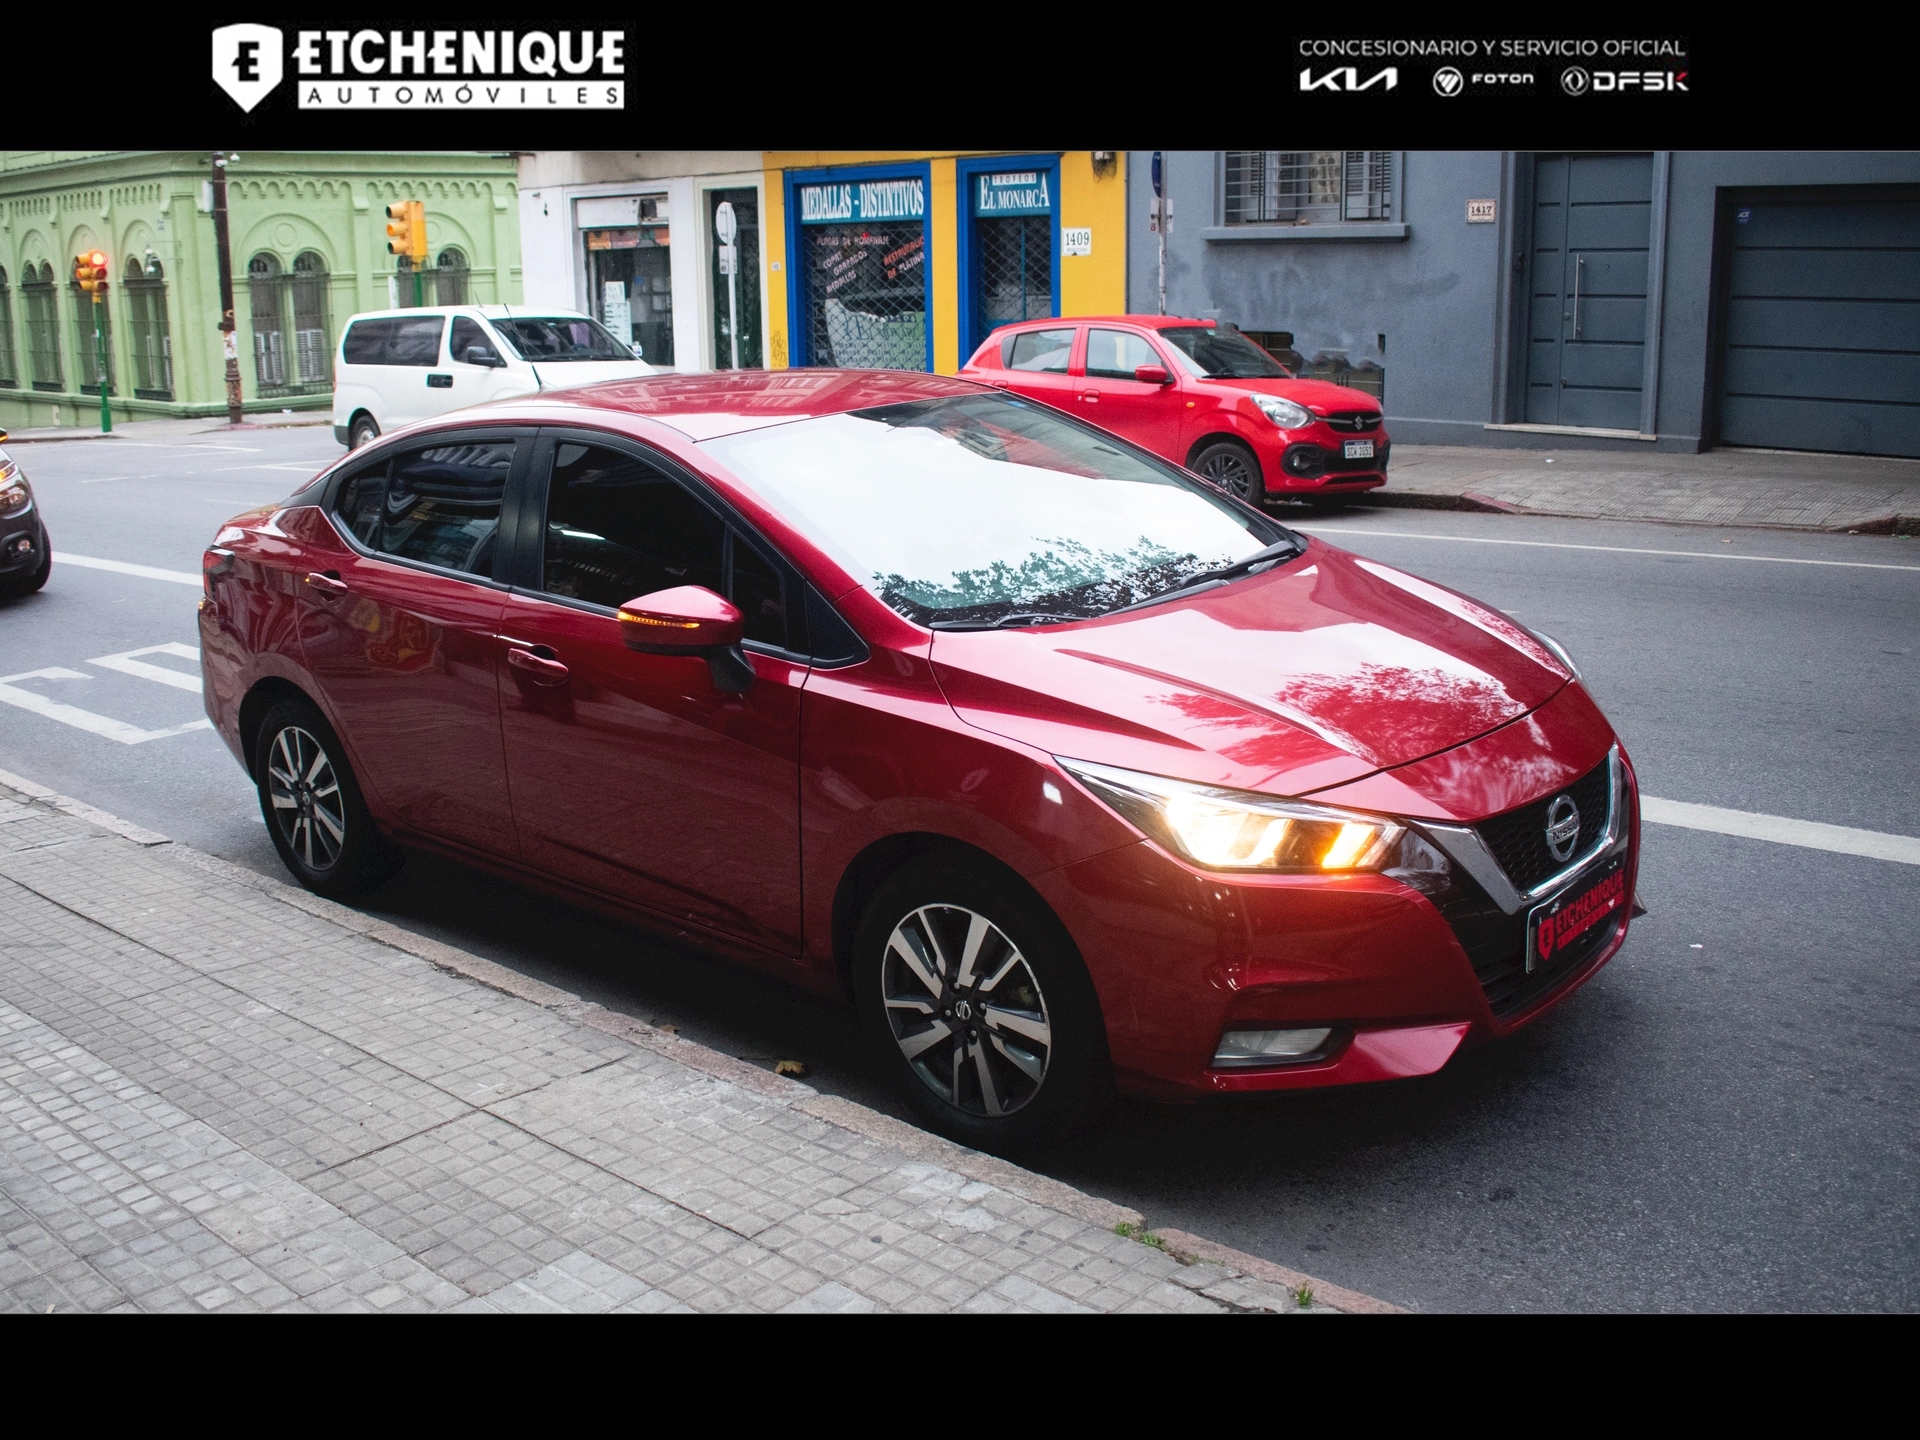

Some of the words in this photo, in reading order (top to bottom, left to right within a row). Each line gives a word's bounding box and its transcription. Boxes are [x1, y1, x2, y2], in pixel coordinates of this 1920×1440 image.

[994, 174, 1036, 185] TROFEOS
[801, 184, 852, 221] MEDALLAS
[859, 179, 924, 217] DISTINTIVOS
[1471, 205, 1492, 213] 1417
[1066, 231, 1089, 246] 1409
[822, 251, 842, 269] COPAS
[825, 269, 857, 294] MEDALLAS
